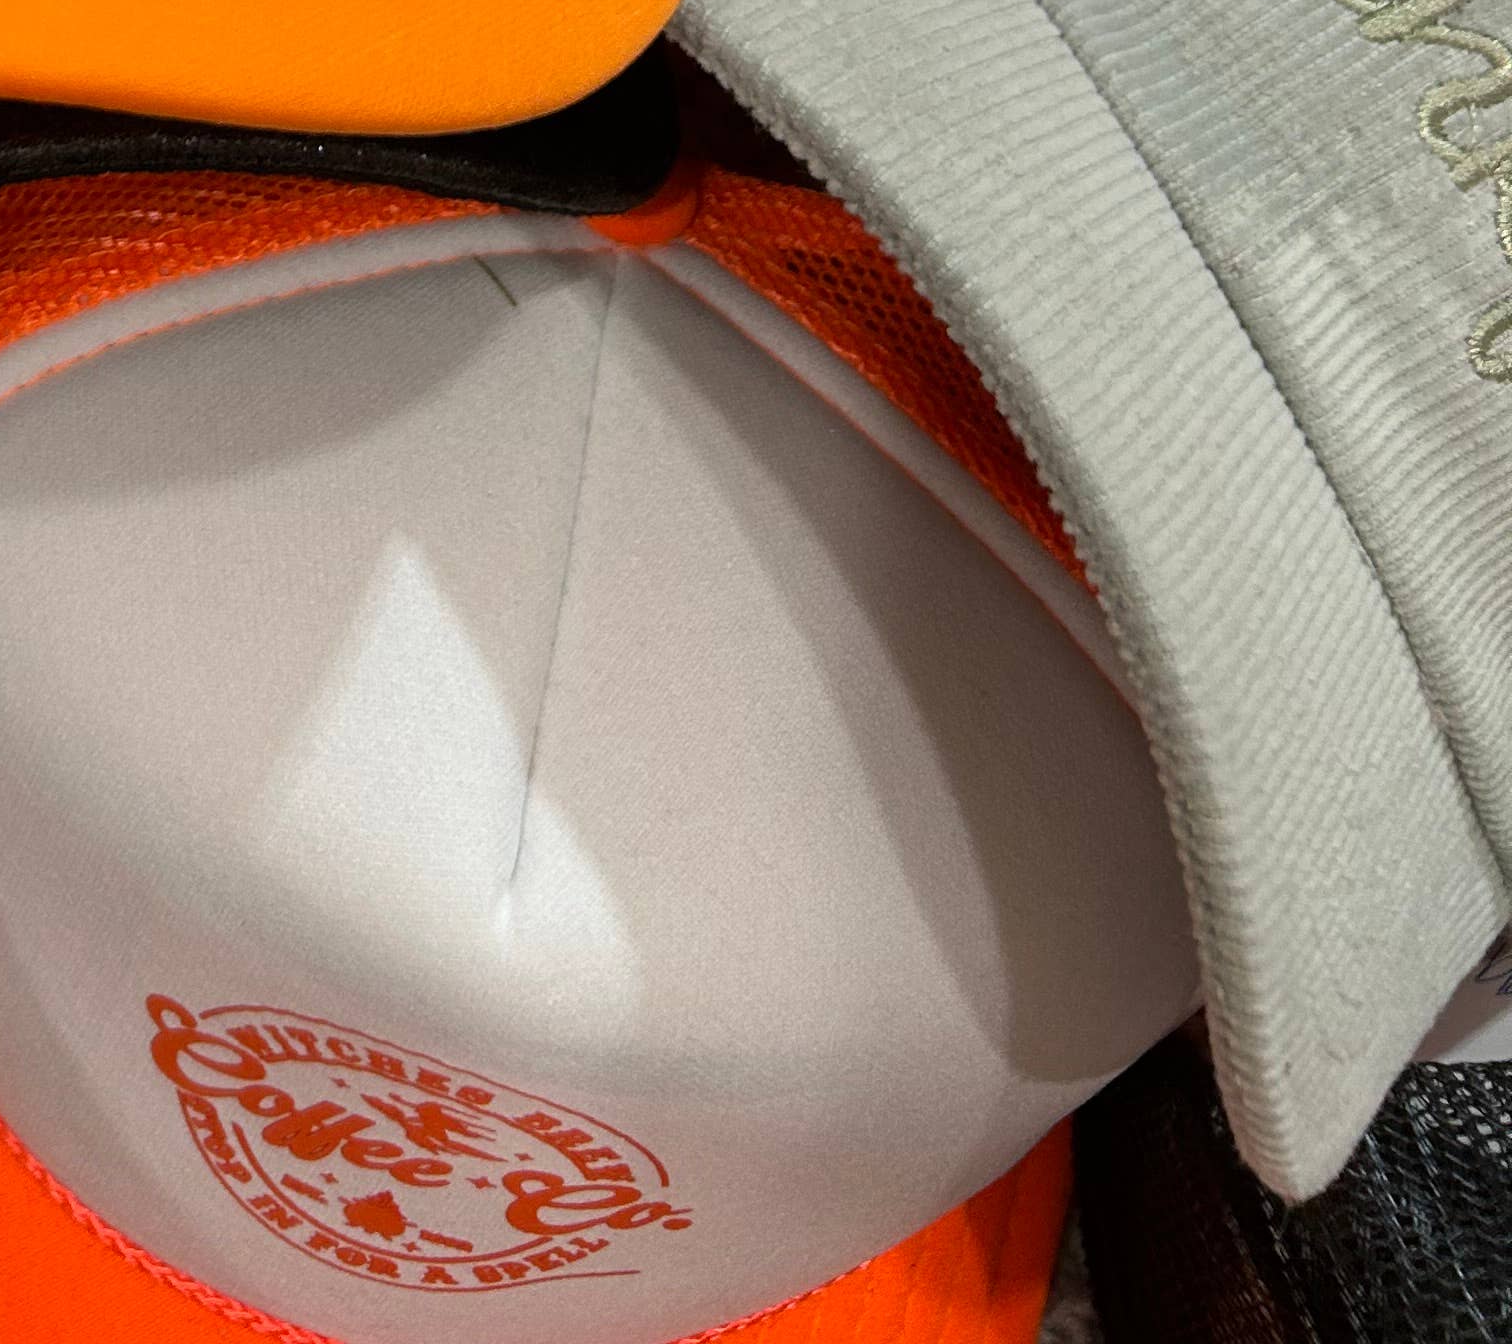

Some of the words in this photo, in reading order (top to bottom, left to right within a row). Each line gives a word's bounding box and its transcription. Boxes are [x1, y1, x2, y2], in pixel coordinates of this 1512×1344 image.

[145, 993, 453, 1187] Coffee
[226, 1024, 494, 1105] WITCHES
[305, 1231, 400, 1278] FOR
